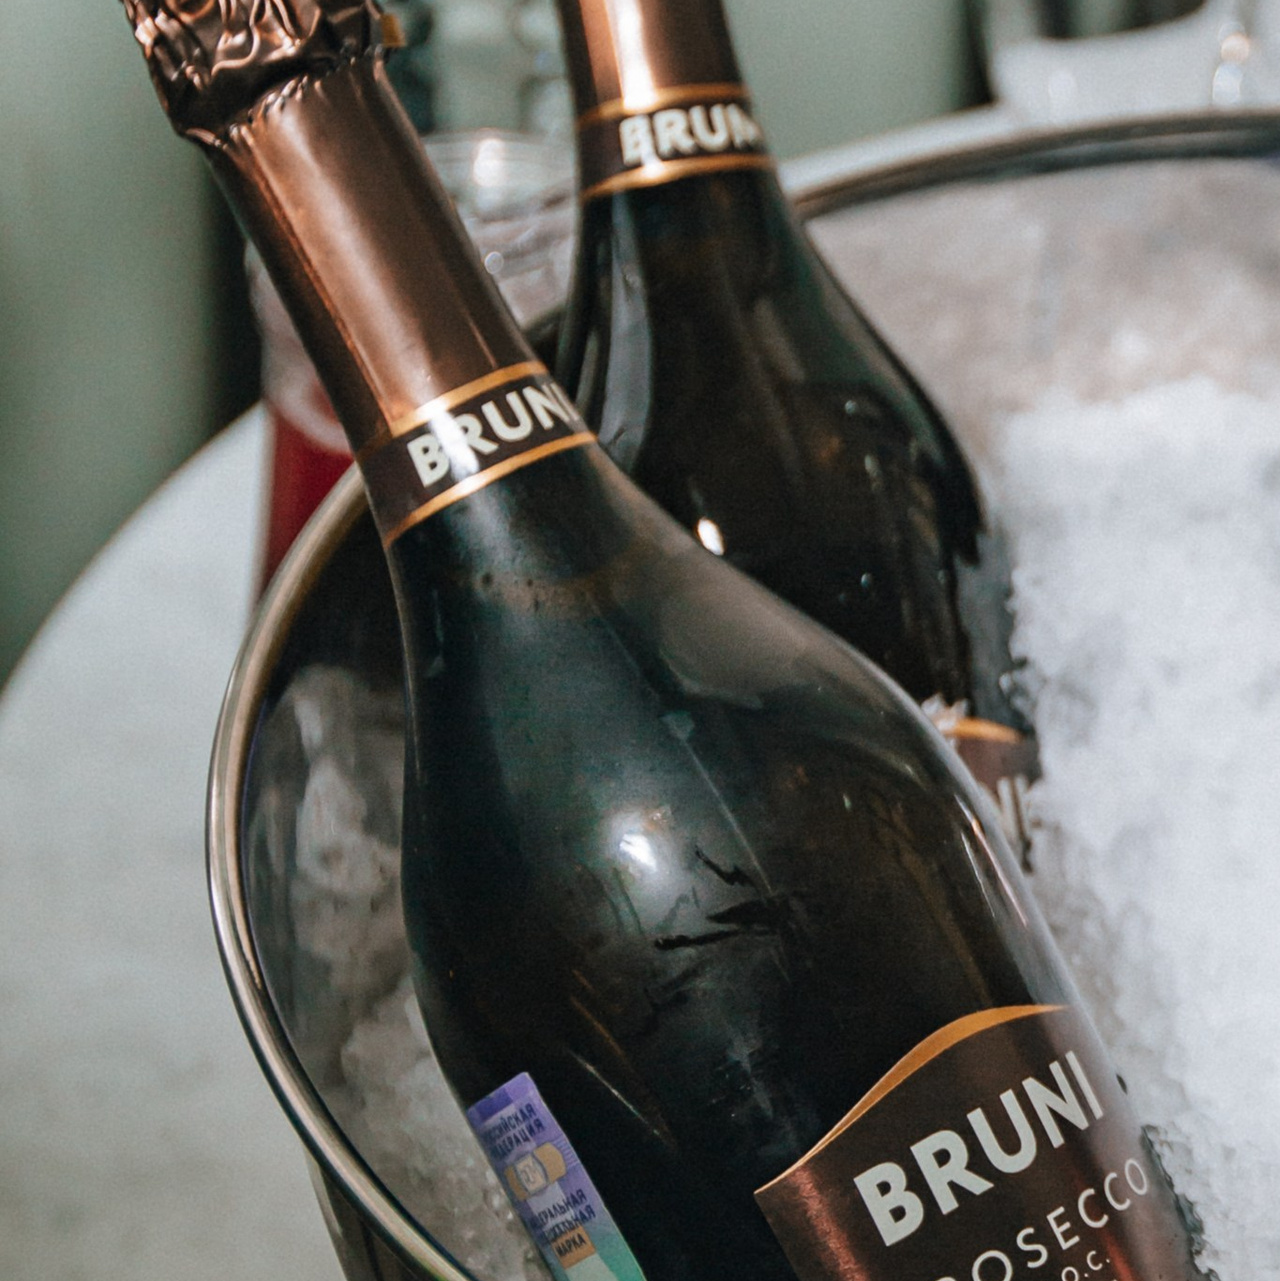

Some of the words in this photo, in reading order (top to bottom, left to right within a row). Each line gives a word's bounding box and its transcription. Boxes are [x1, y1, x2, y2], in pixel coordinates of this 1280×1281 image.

[618, 103, 763, 167] BRUN
[853, 1050, 1104, 1247] BRUNI
[555, 1232, 587, 1257] МАРКА
